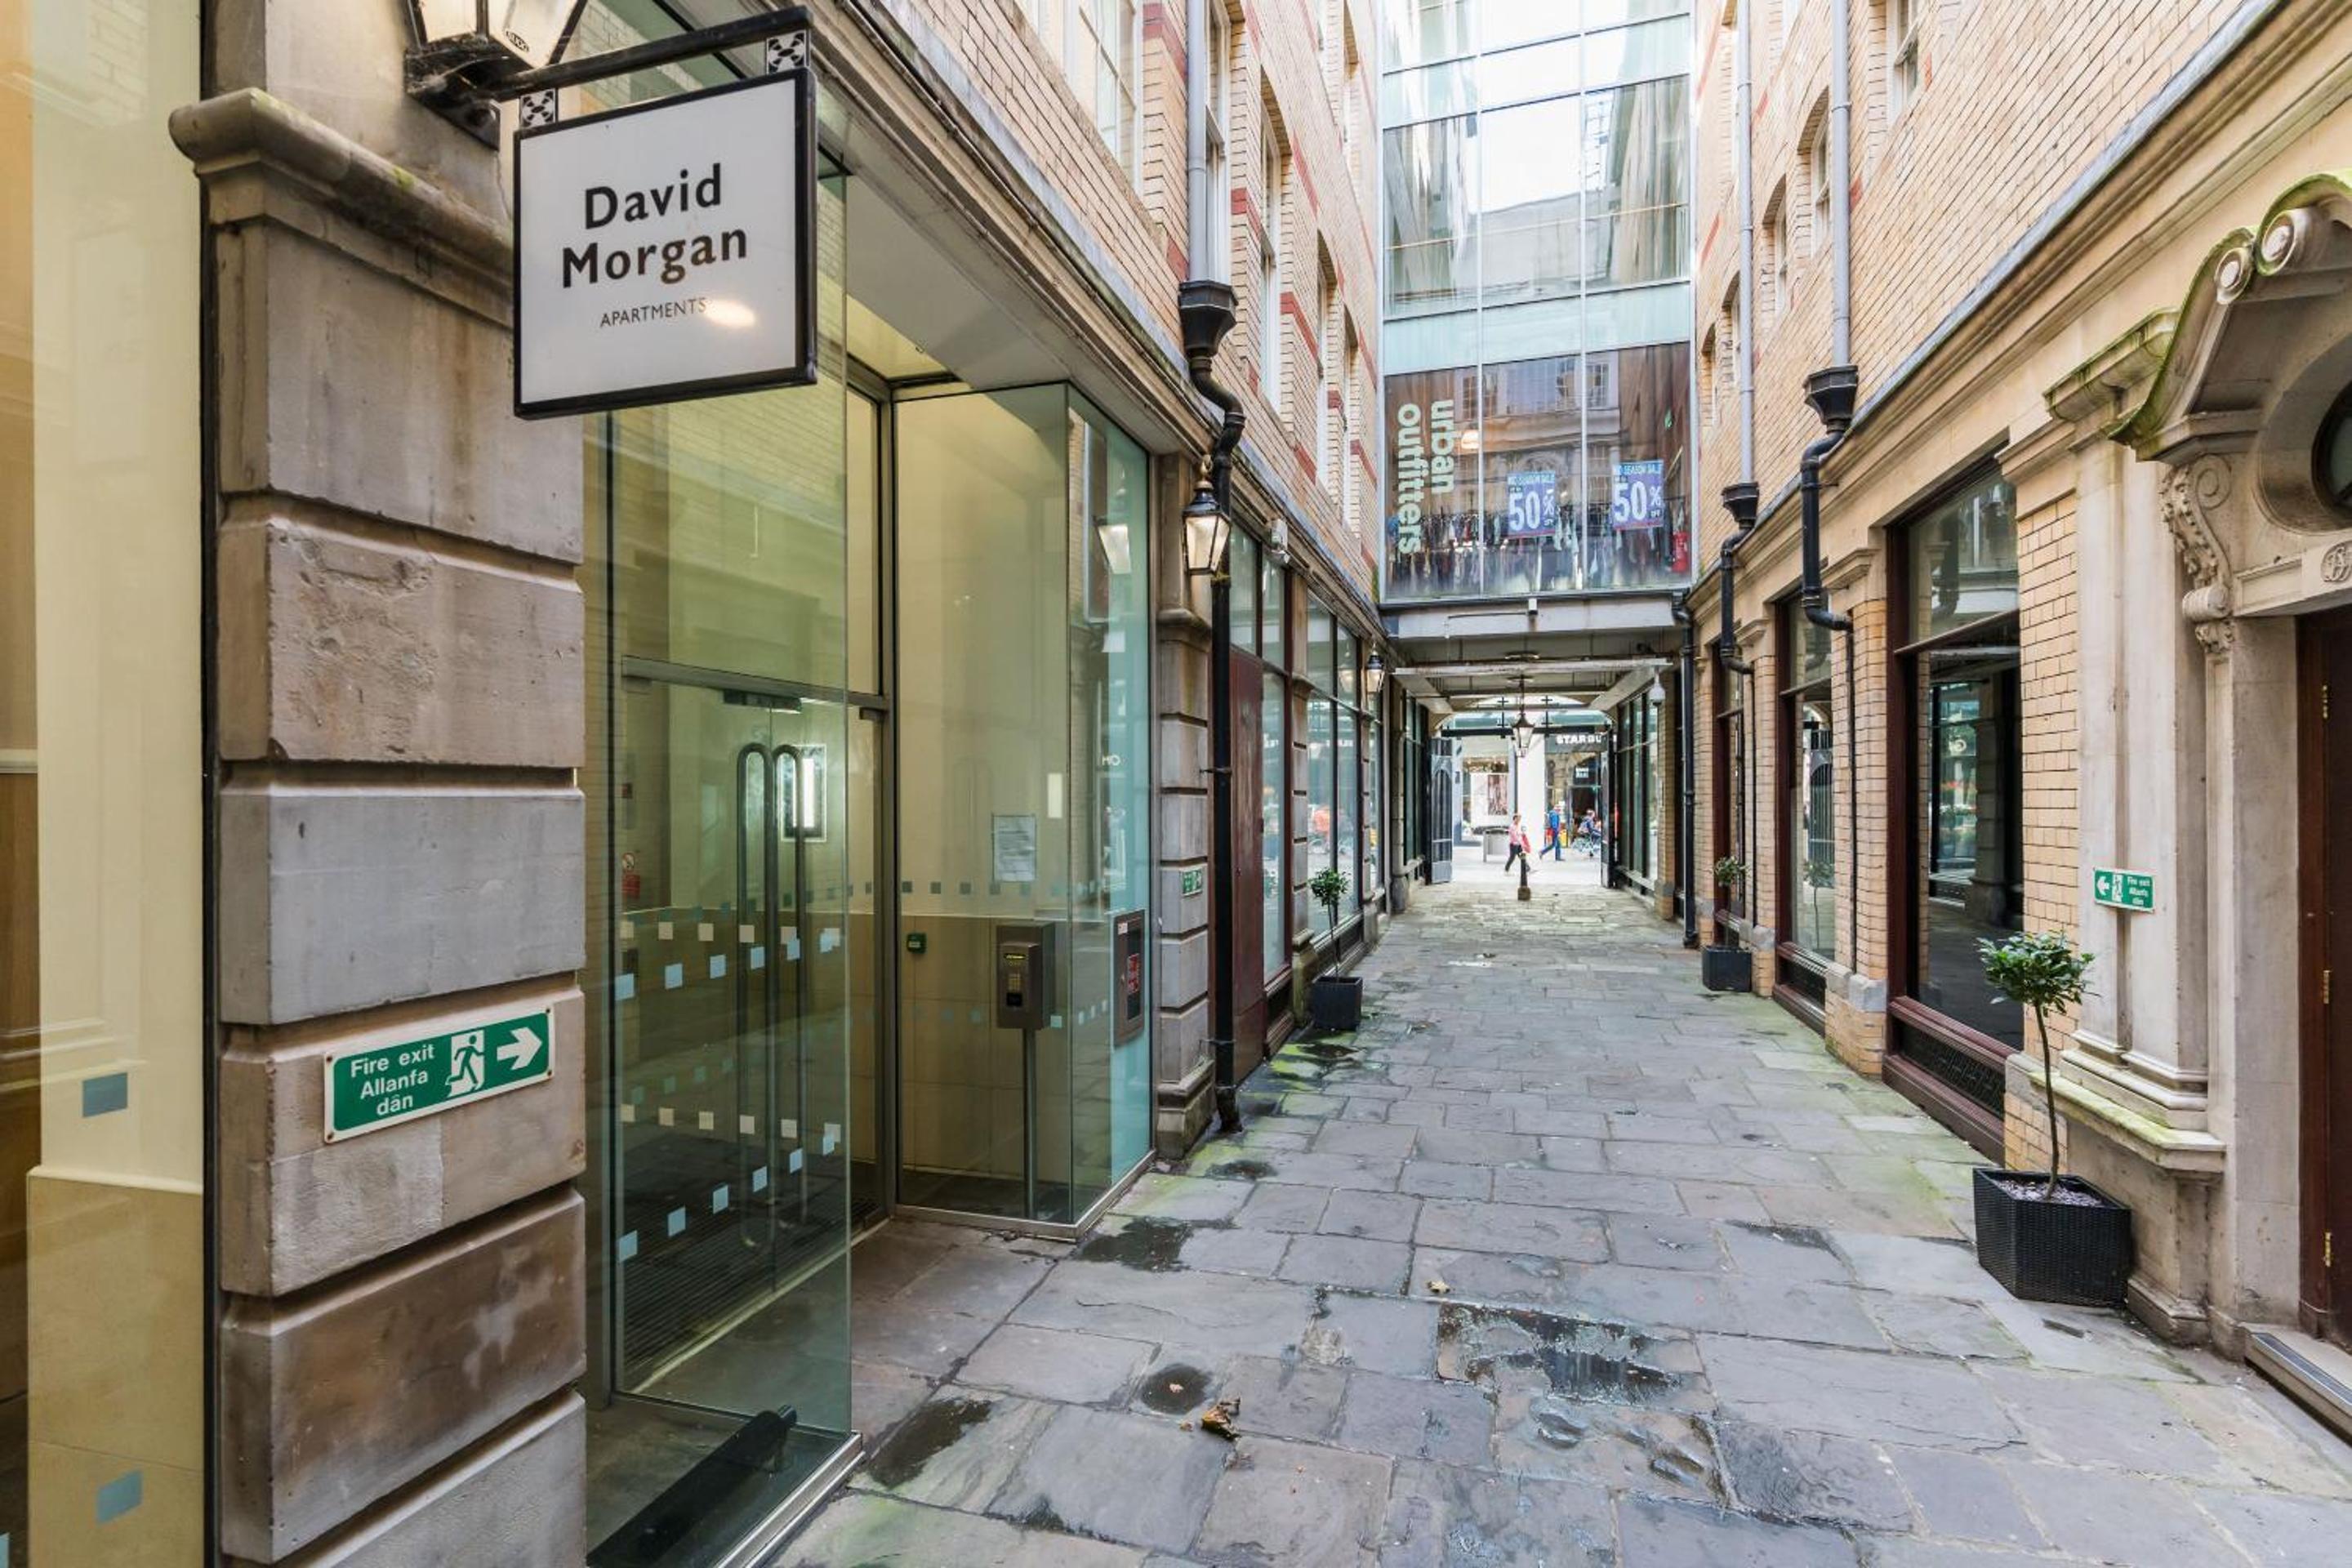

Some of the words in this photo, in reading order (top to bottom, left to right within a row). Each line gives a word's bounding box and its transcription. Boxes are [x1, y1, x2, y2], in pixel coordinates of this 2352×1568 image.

[586, 163, 720, 229] David
[563, 229, 746, 288] Morgan
[600, 297, 707, 328] APARTMENTS
[1432, 399, 1454, 493] urban
[1397, 403, 1429, 554] outfitters
[1556, 734, 1617, 744] STARBU
[350, 1058, 390, 1078] Fire
[399, 1044, 435, 1066] exit
[360, 1069, 429, 1100] Allanfa
[376, 1094, 413, 1116] dân
